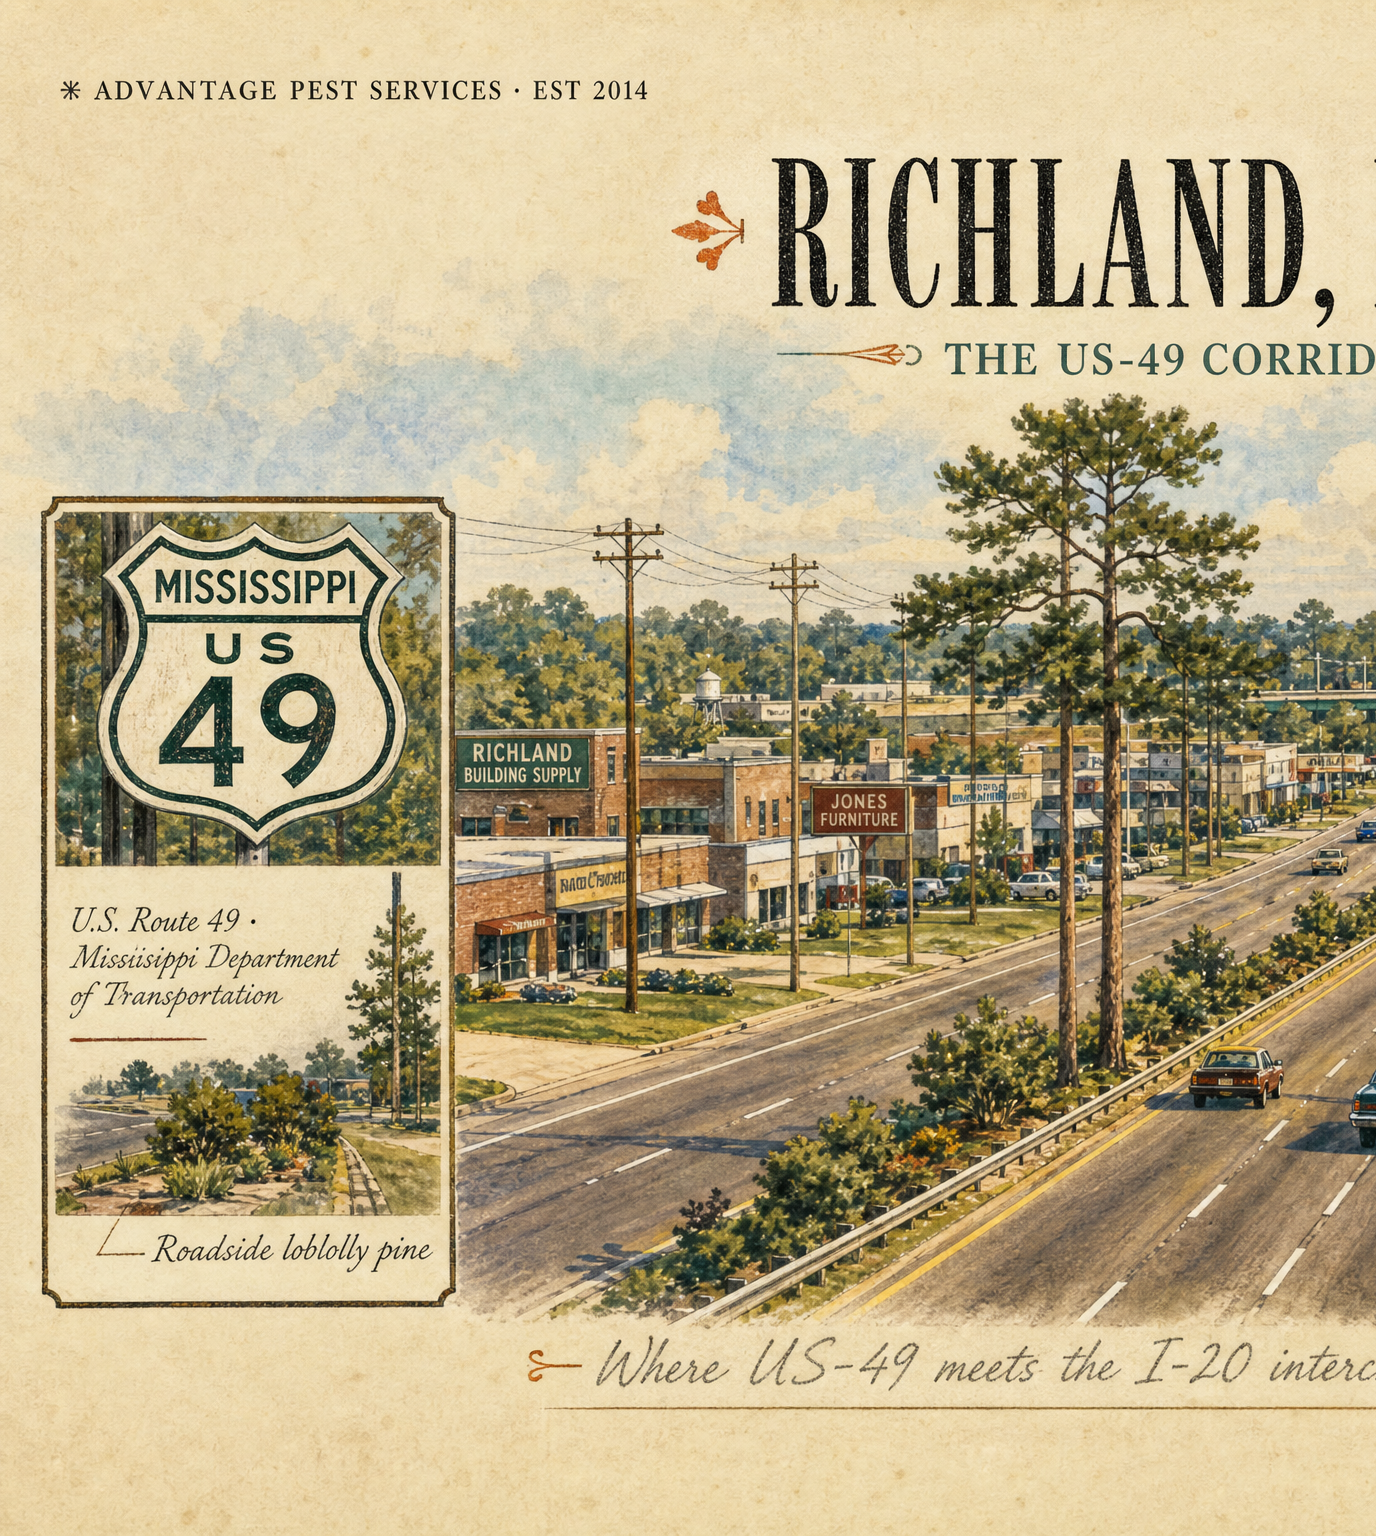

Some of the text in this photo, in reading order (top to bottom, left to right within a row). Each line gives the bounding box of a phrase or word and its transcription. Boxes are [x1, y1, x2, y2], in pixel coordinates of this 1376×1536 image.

[155, 569, 355, 604] MISSISSIPPI
[206, 632, 293, 664] US
[159, 674, 336, 788] 49
[474, 743, 571, 762] RICHLAND
[465, 767, 581, 783] BUILDING SUPPLY
[832, 794, 886, 809] JONES
[821, 813, 897, 826] FURNITURE
